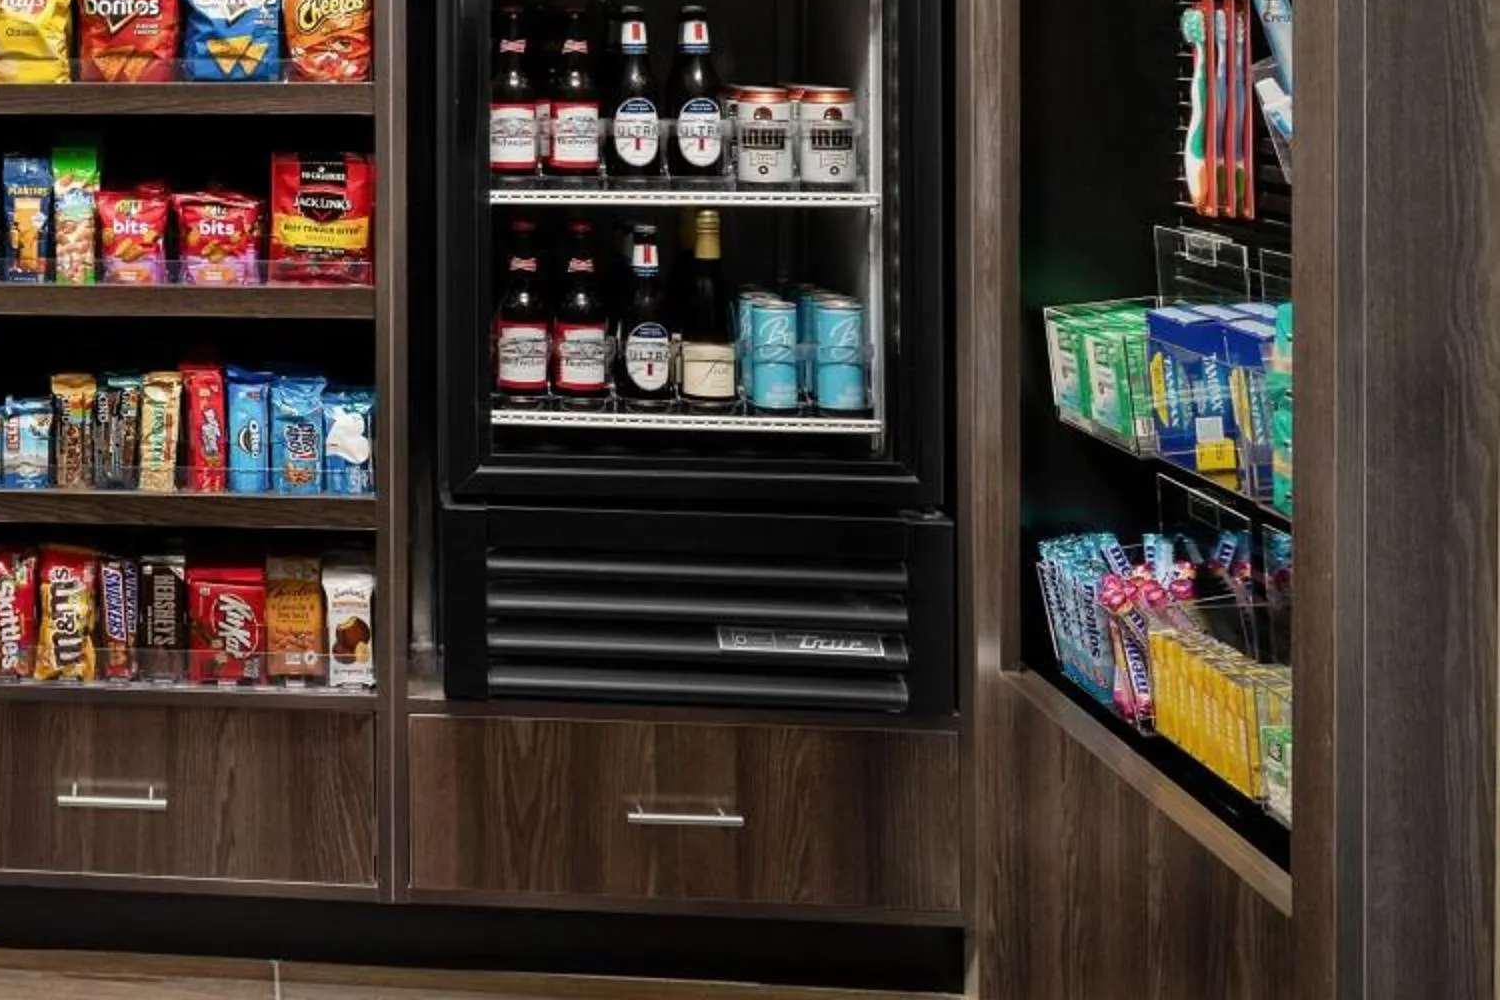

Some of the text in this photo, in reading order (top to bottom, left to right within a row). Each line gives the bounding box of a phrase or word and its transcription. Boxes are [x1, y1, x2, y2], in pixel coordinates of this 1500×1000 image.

[113, 213, 149, 235] bits
[199, 214, 235, 235] bits
[104, 570, 125, 639] SNICKERS
[154, 575, 176, 645] HERSHEY'S
[1083, 585, 1100, 659] mentos
